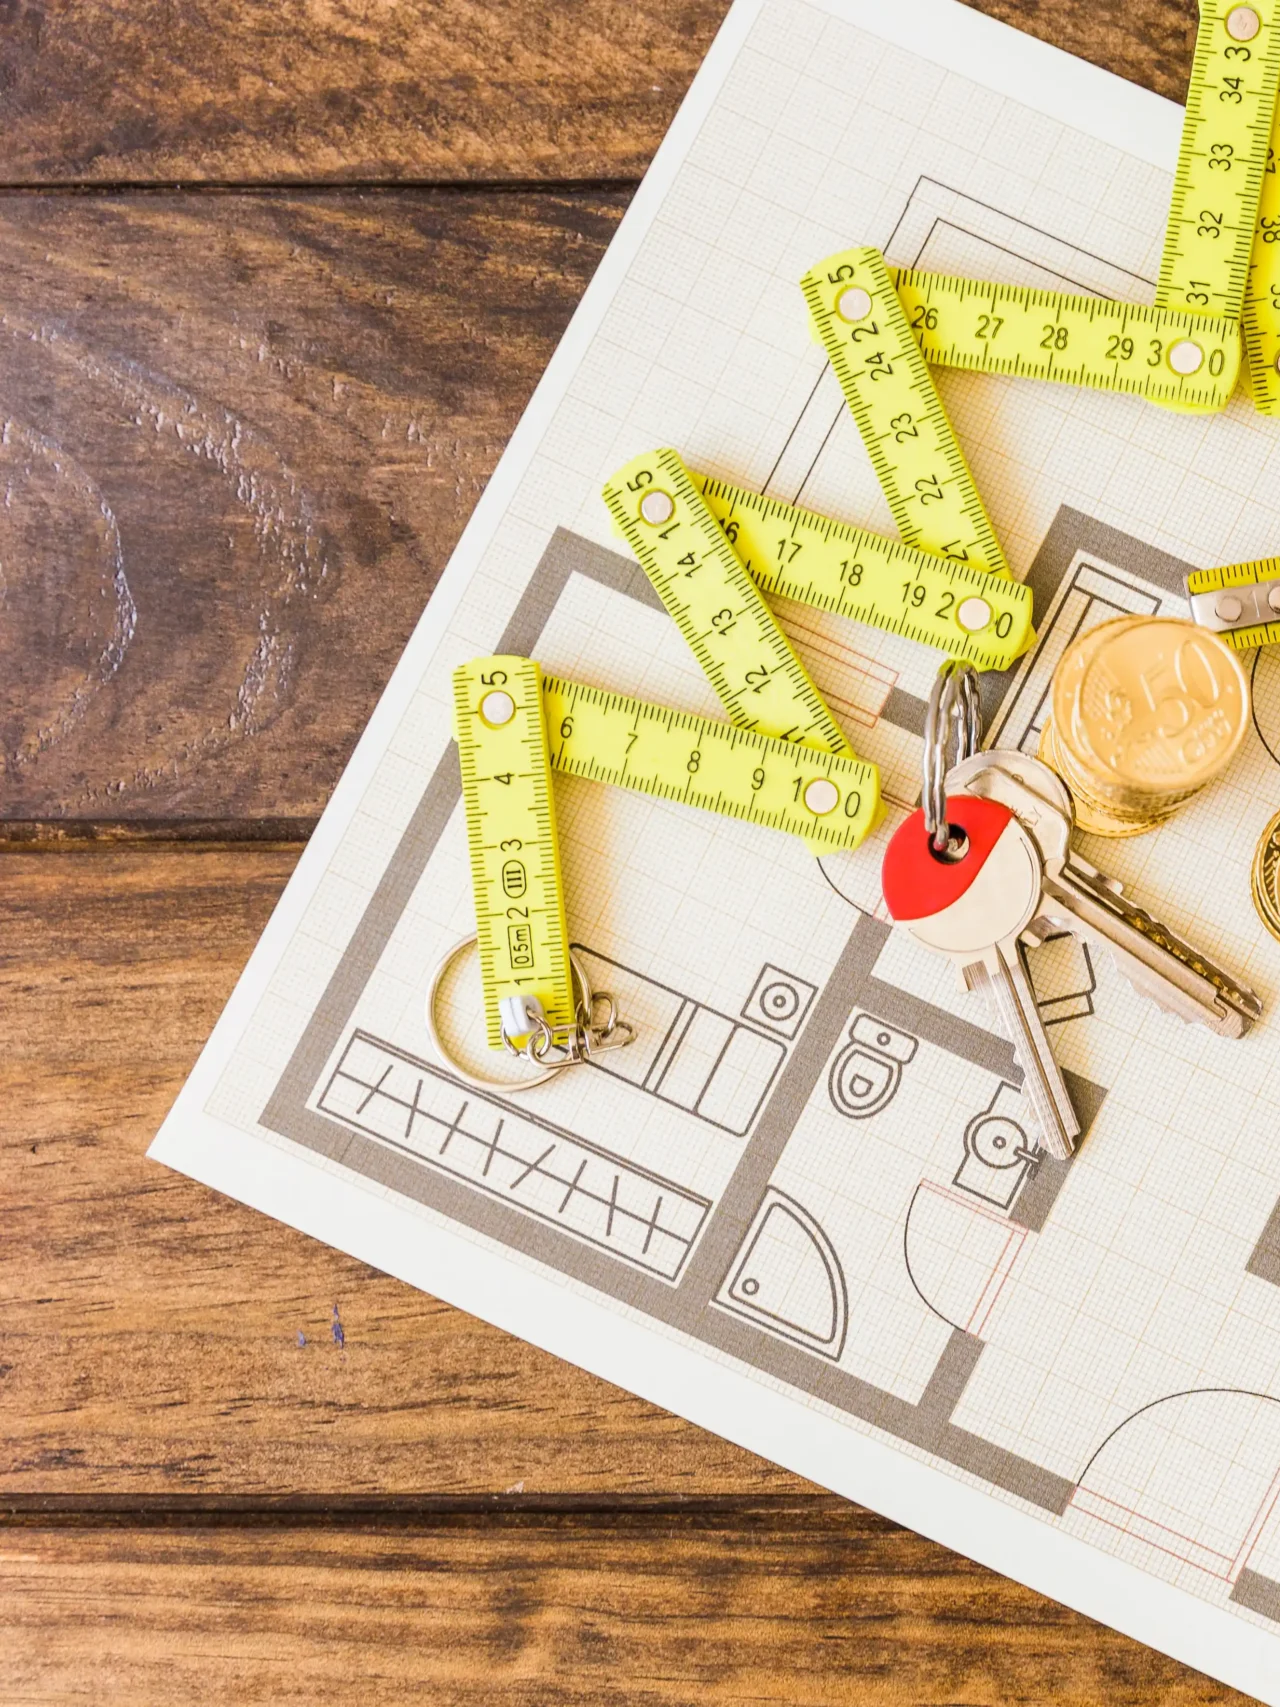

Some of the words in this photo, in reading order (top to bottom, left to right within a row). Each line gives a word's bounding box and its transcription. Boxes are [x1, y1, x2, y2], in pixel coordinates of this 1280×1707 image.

[1219, 77, 1244, 104] 34
[1208, 143, 1234, 172] 33
[1196, 210, 1224, 239] 32
[1185, 280, 1211, 306] 31
[912, 306, 939, 329] 26
[974, 314, 1005, 339] 27
[1039, 324, 1069, 351] 28
[1105, 335, 1134, 361] 29
[864, 351, 894, 382] 24
[890, 413, 919, 444] 23
[914, 474, 944, 506] 22
[676, 551, 703, 578] 14
[777, 538, 803, 564] 17
[839, 560, 864, 587] 18
[902, 581, 926, 608] 19
[711, 608, 737, 636] 13
[480, 670, 508, 686] 5
[744, 664, 771, 694] 12
[559, 716, 574, 739] 6
[625, 732, 639, 755] 7
[686, 750, 702, 774] 8
[751, 767, 765, 791] 9
[493, 772, 515, 786] 4
[499, 838, 523, 852] 3
[506, 906, 529, 920] 2
[514, 978, 534, 986] 1
